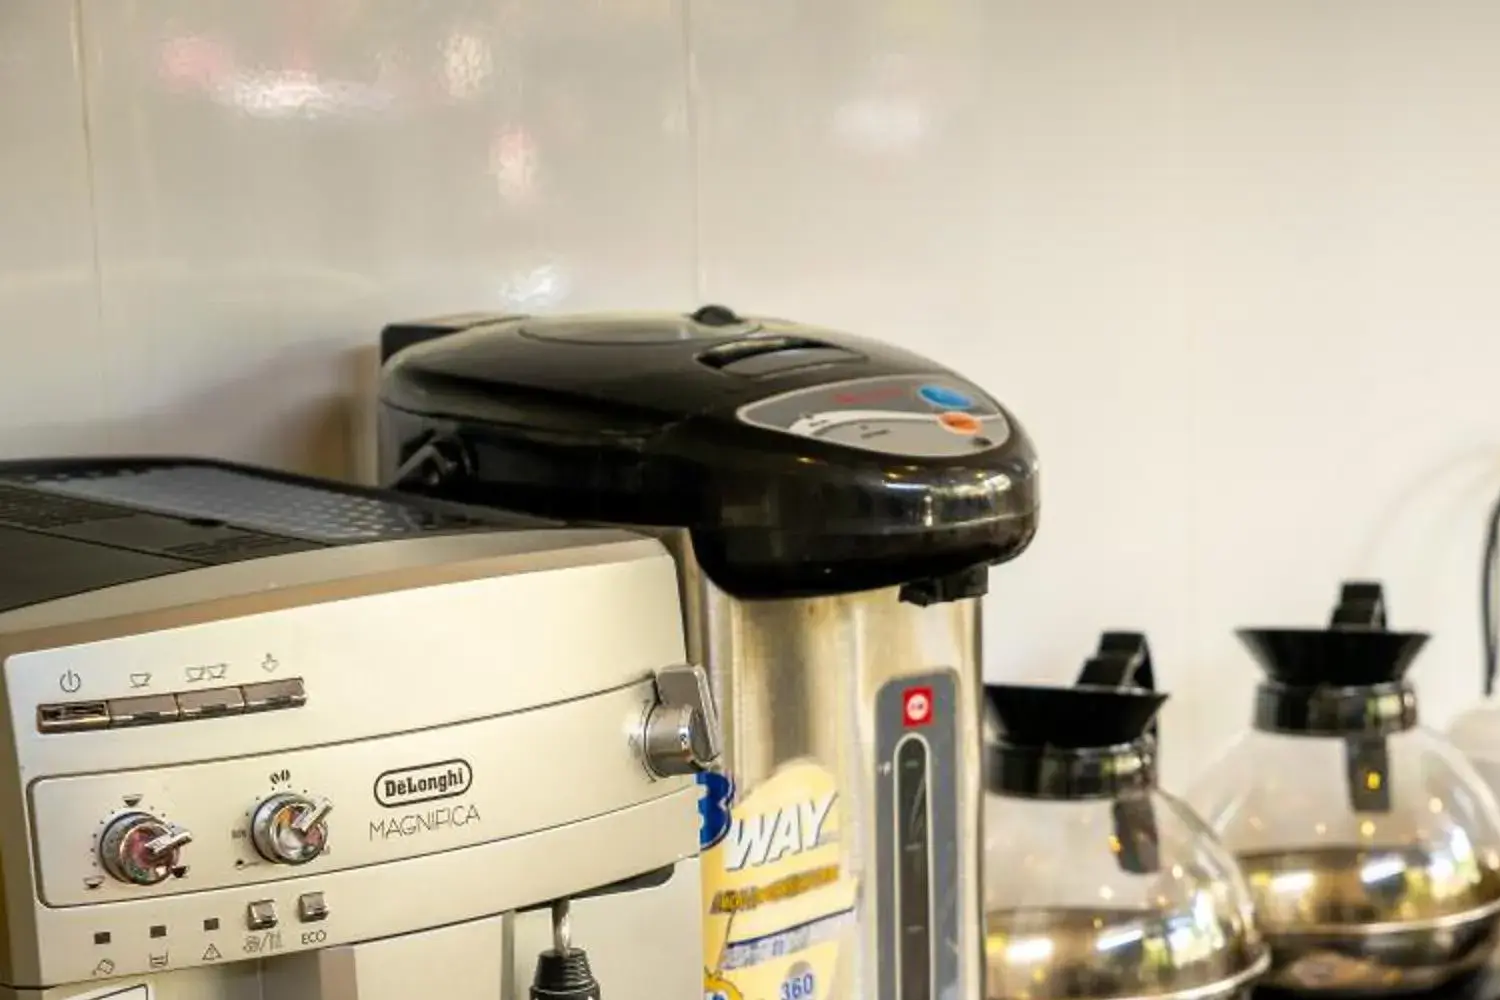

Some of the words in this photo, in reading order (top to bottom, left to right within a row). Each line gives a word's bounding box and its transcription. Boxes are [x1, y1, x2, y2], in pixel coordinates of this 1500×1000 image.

[369, 804, 481, 842] MAGNIFICA
[724, 791, 839, 872] WAY
[301, 930, 327, 945] ECO
